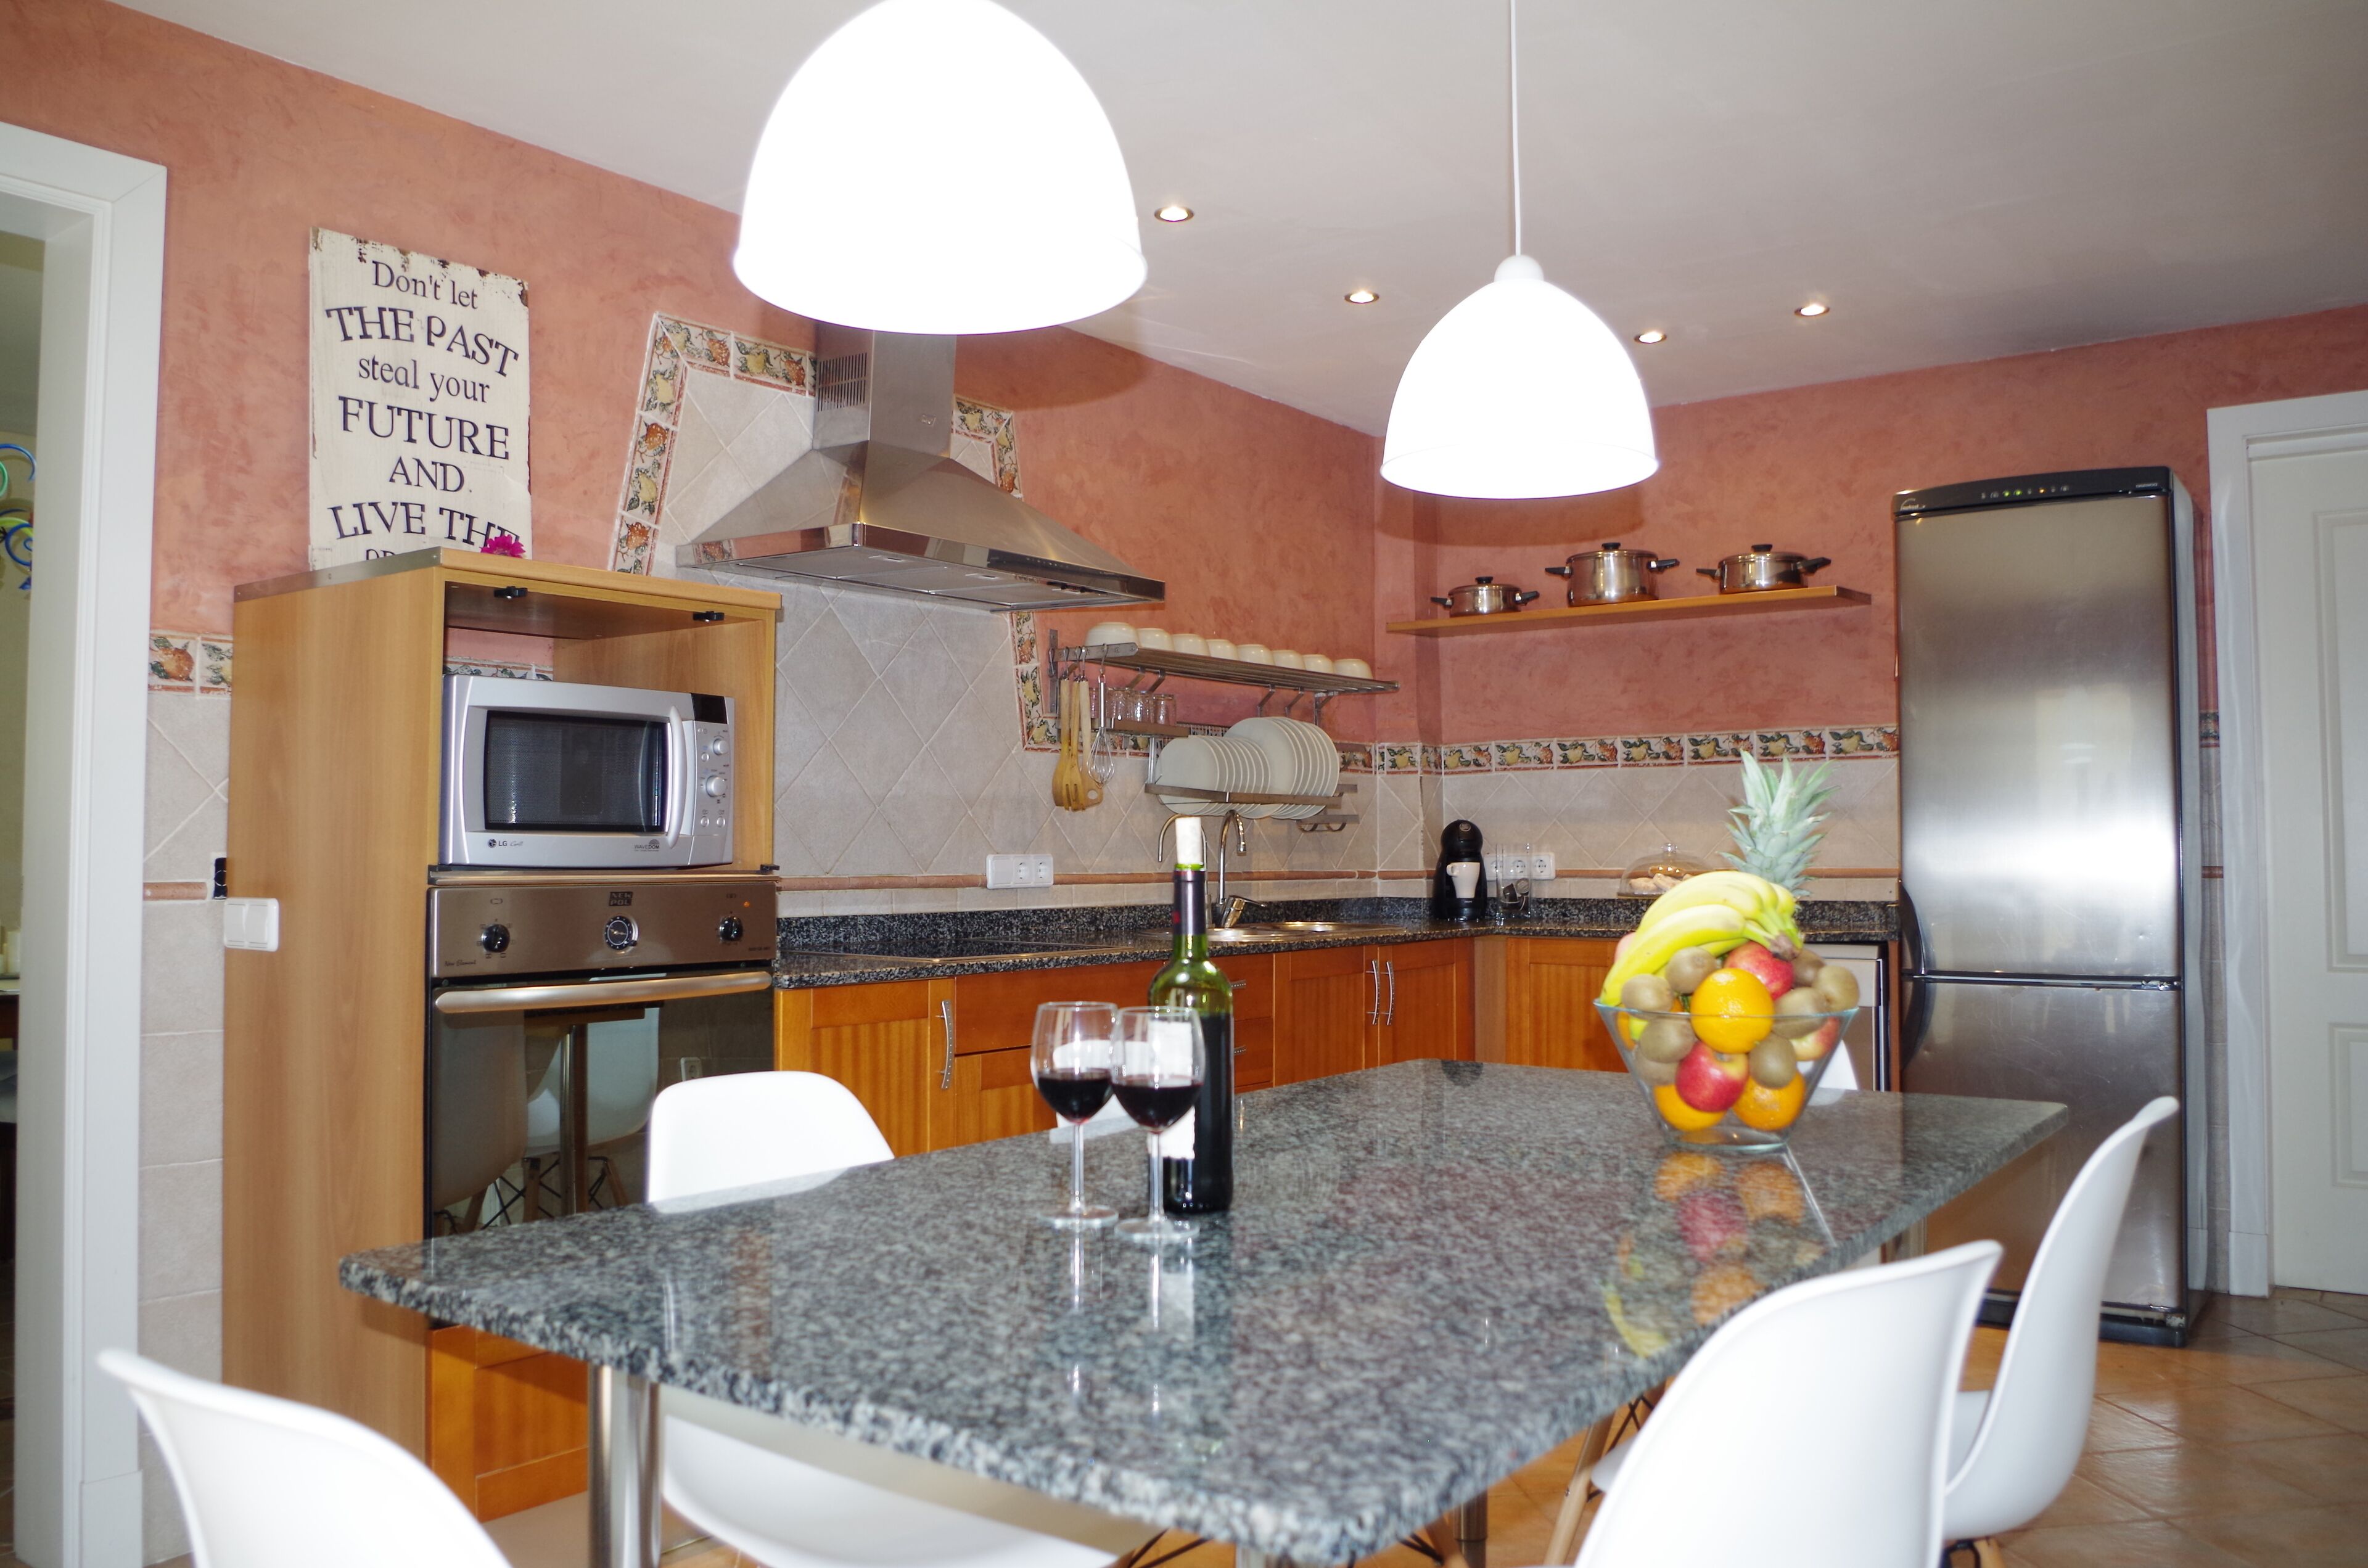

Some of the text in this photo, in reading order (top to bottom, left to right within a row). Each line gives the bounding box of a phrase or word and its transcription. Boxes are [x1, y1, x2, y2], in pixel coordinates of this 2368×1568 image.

[372, 260, 478, 310] Don't let
[326, 306, 519, 377] THE PAST
[359, 355, 490, 403] steal your
[339, 396, 509, 461] FUTURE
[328, 501, 426, 540] LIVE
